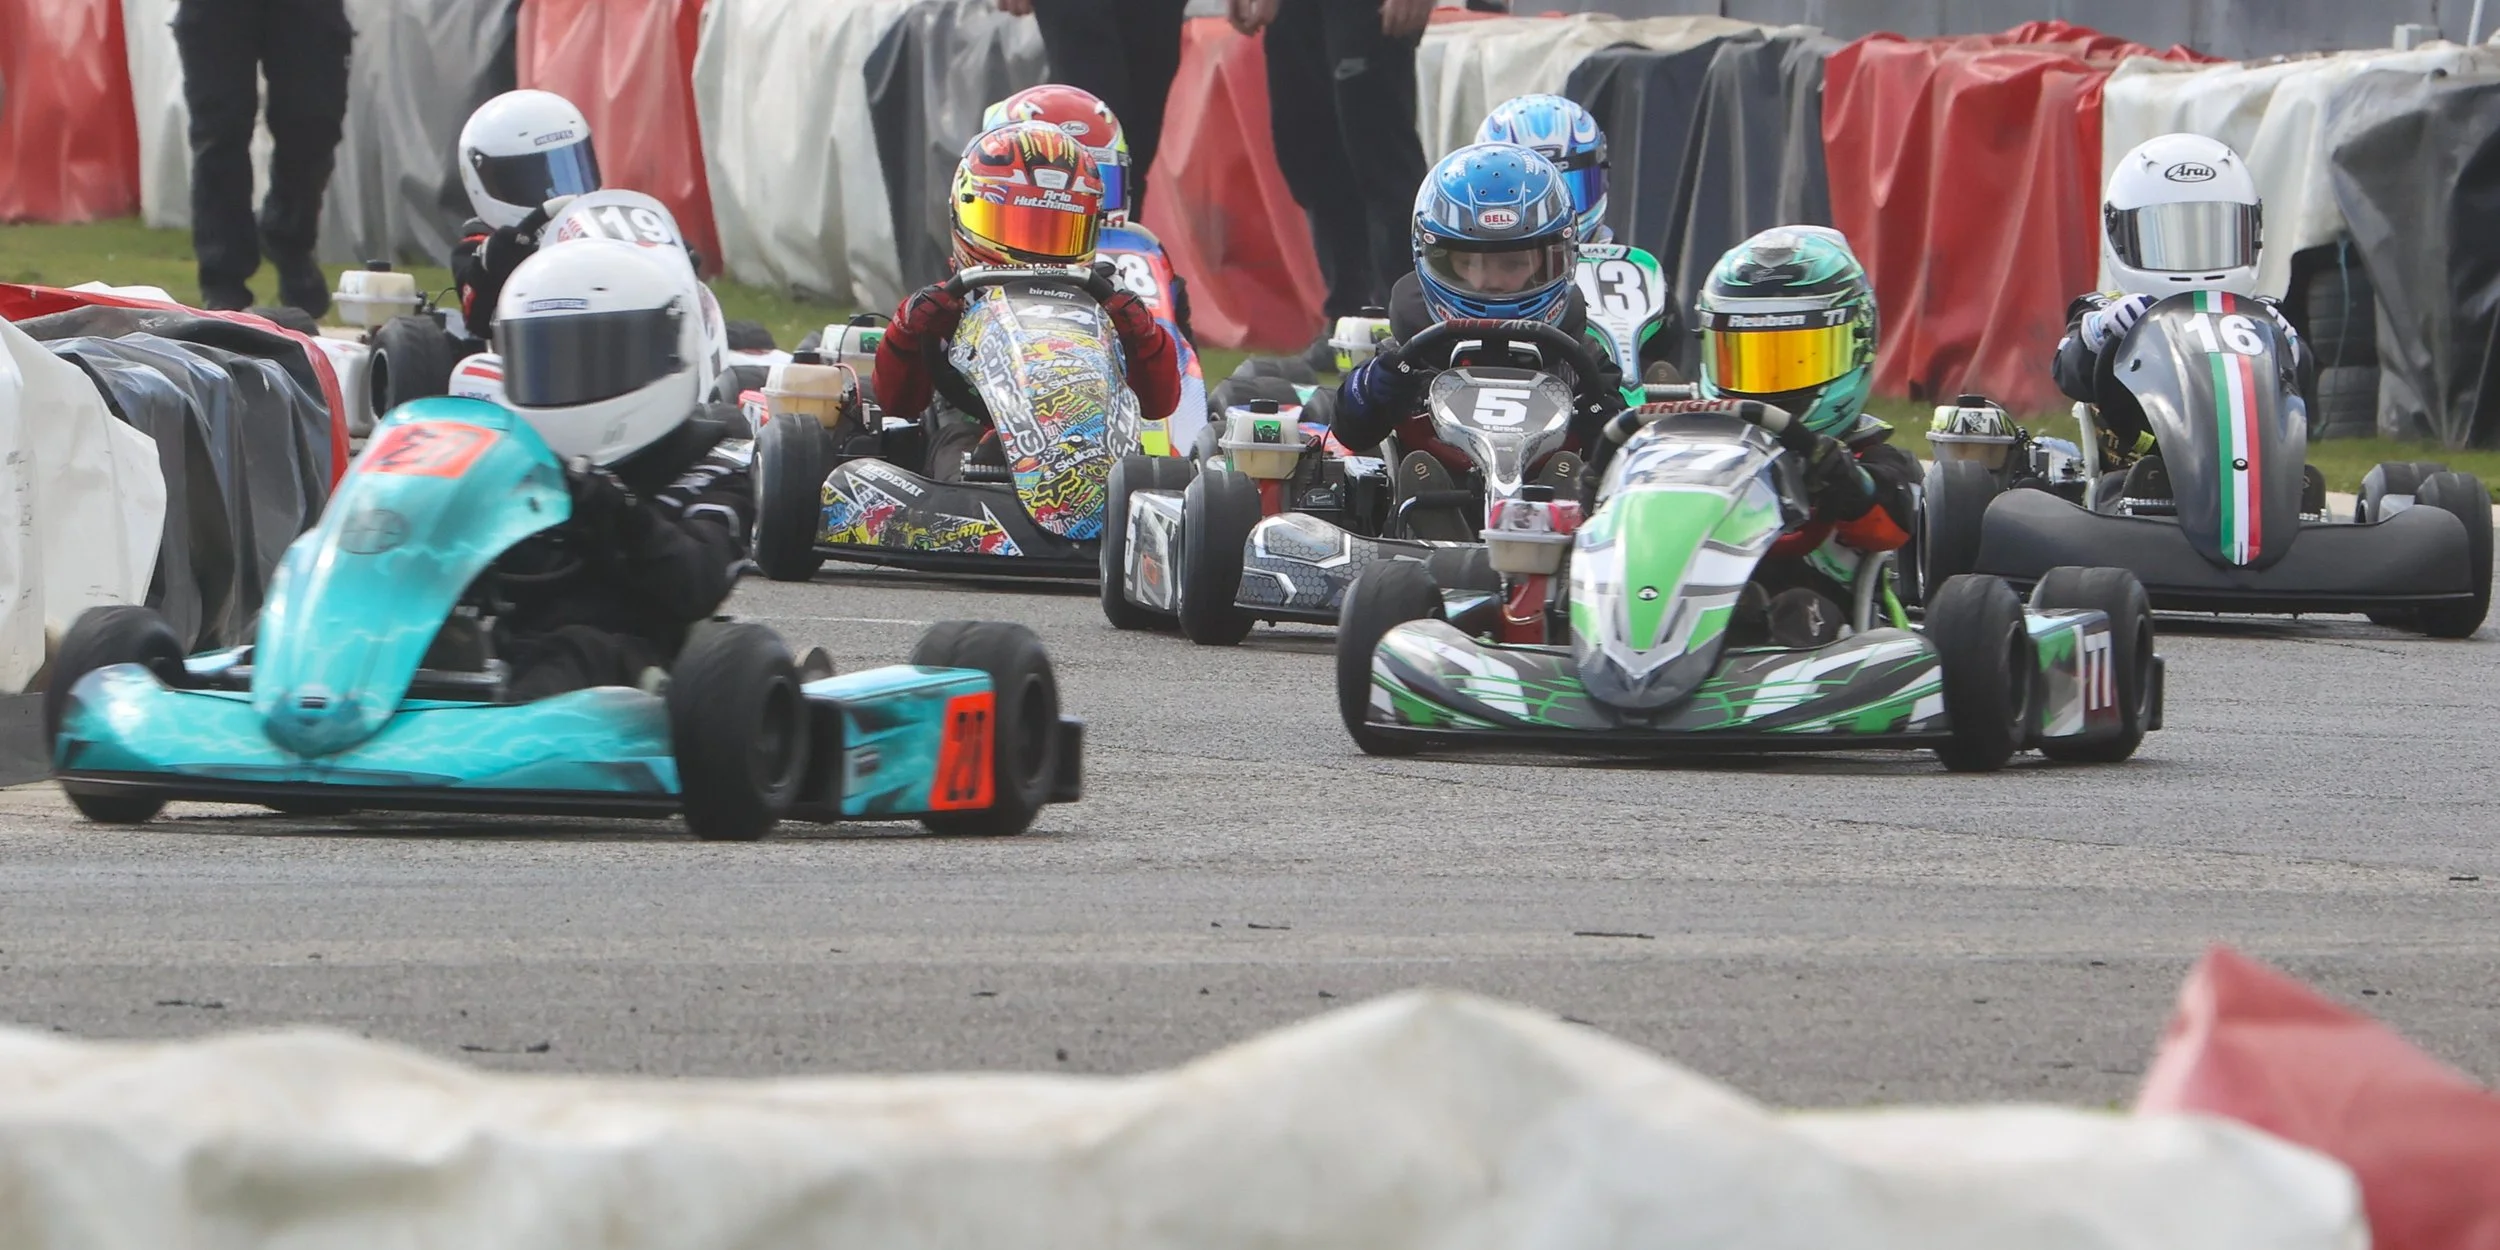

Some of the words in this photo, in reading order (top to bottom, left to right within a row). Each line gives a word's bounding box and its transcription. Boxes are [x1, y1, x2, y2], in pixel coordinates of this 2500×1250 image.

[2170, 164, 2211, 178] Arai
[1013, 195, 1085, 214] Hutchinson
[1043, 190, 1072, 202] Arlo
[1484, 212, 1514, 223] BELL
[1028, 287, 1076, 300] birelART
[1575, 260, 1649, 319] 13
[1016, 304, 1097, 326] 44
[1728, 314, 1807, 328] Reuben
[1822, 308, 1847, 326] 77
[2184, 312, 2264, 355] 16
[1472, 387, 1532, 426] 5
[1628, 443, 1751, 475] 77
[2084, 630, 2112, 711] 77
